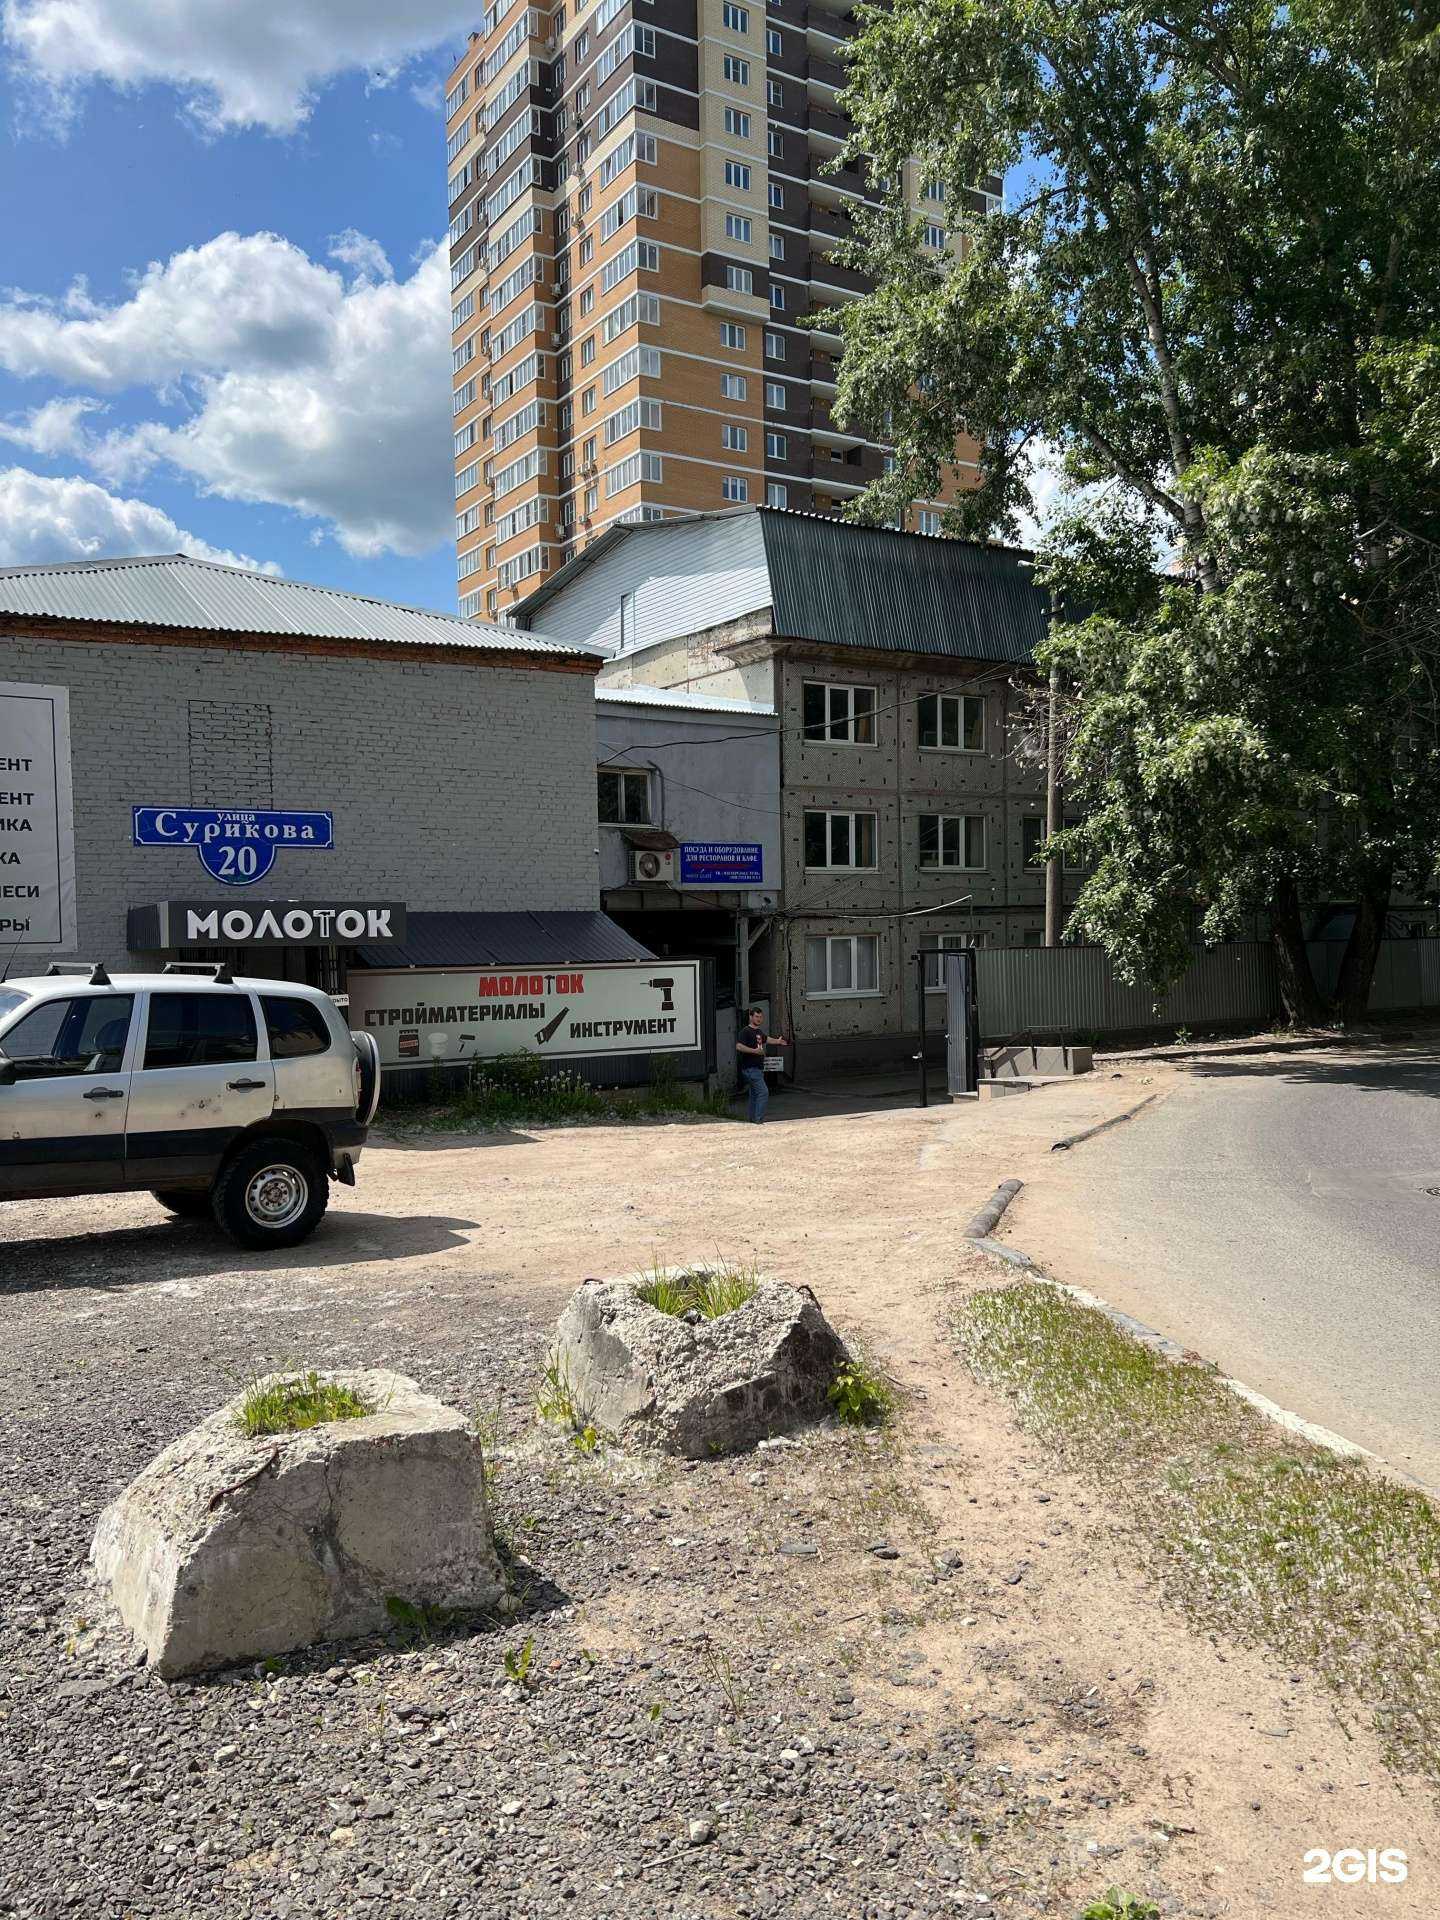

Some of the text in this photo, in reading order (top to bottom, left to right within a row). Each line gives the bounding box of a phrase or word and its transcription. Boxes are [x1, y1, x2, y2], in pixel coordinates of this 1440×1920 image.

[155, 812, 315, 842] Сурикова
[217, 812, 256, 823] улица
[218, 846, 257, 875] 20
[0, 885, 40, 898] ЕСИ
[187, 909, 393, 940] МОЛОТОК
[478, 973, 584, 997] МОЛОТОК
[364, 1002, 546, 1026] СТРОЙМАТЕРИАЛЫ
[570, 1018, 677, 1039] ИНСТРУМЕНТ
